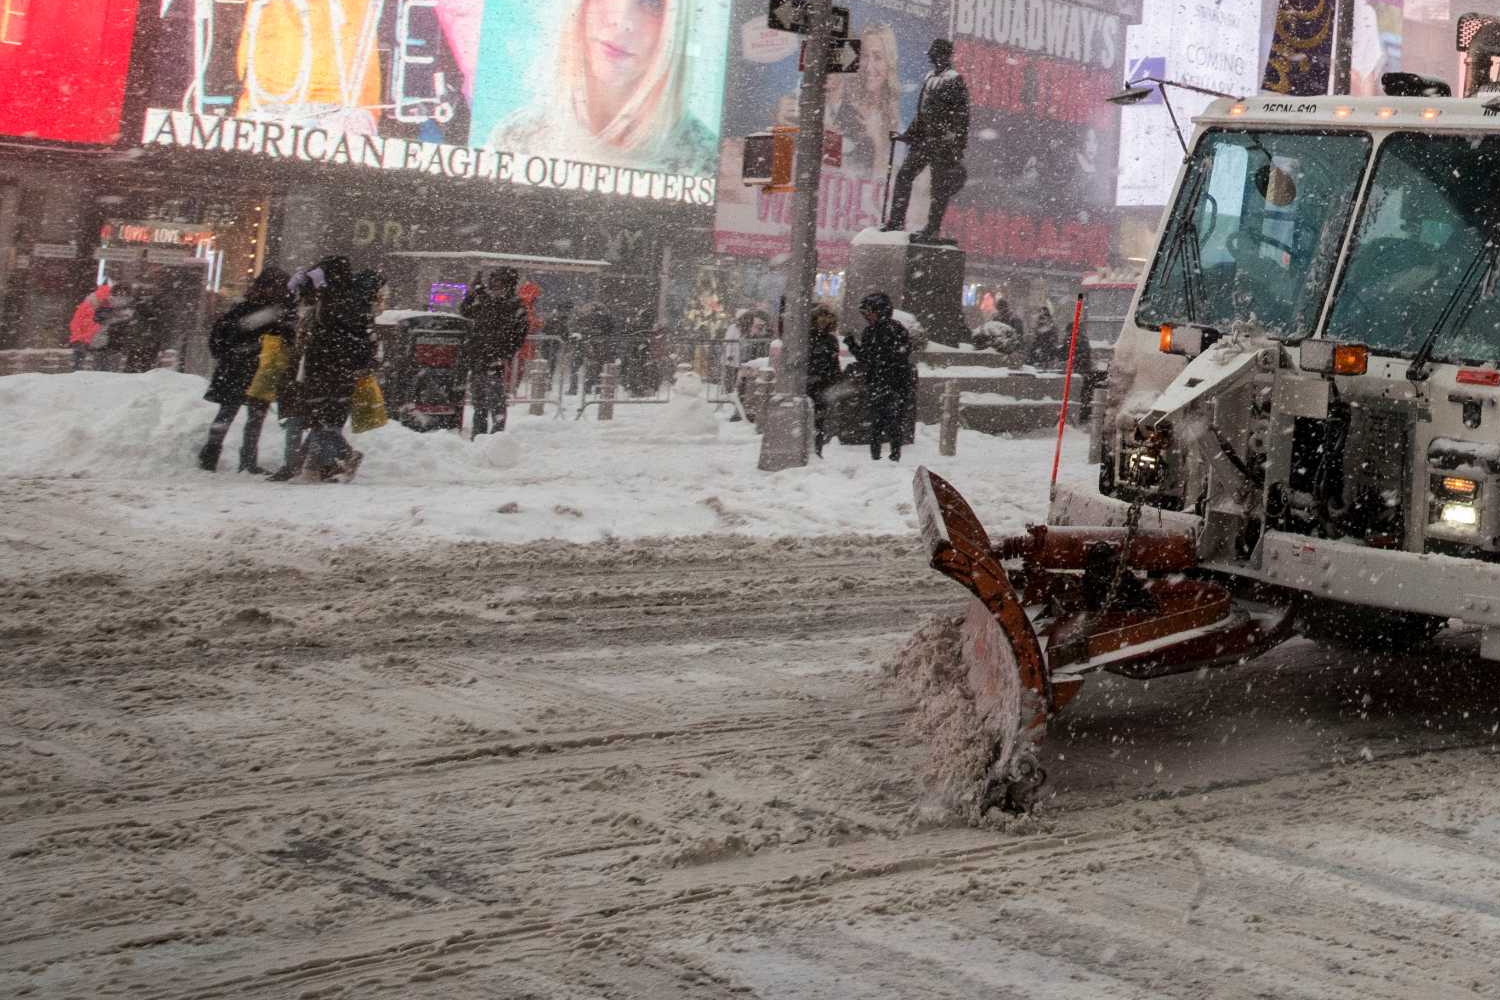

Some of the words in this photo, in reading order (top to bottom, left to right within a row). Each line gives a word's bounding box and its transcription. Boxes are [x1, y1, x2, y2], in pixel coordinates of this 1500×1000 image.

[1186, 43, 1244, 76] COMING
[154, 114, 389, 171] AMERICAN
[404, 140, 515, 184] EAGLE
[526, 155, 716, 208] OUTFITTERS
